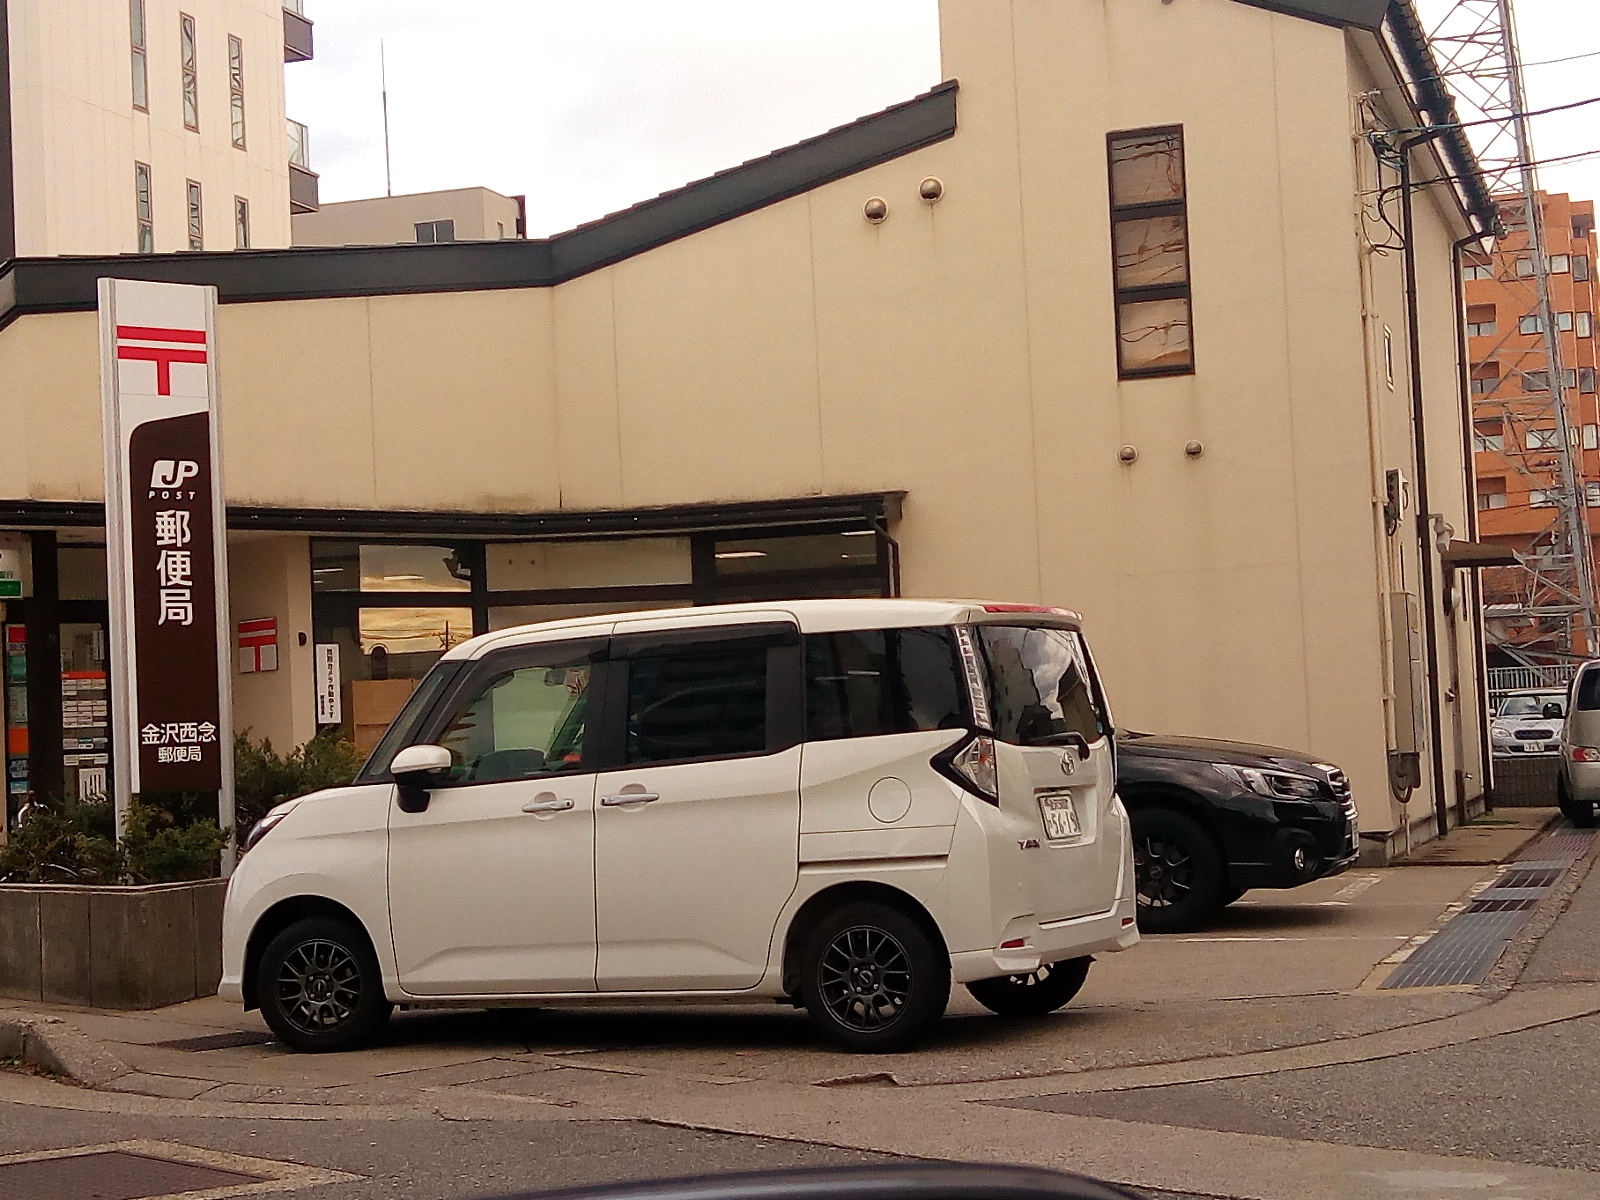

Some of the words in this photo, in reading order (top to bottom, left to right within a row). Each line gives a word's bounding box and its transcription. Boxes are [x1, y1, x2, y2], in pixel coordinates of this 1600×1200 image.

[148, 490, 196, 500] POST
[155, 509, 194, 626] 郵便局
[141, 721, 217, 745] 金沢西念
[157, 745, 202, 763] 郵便局
